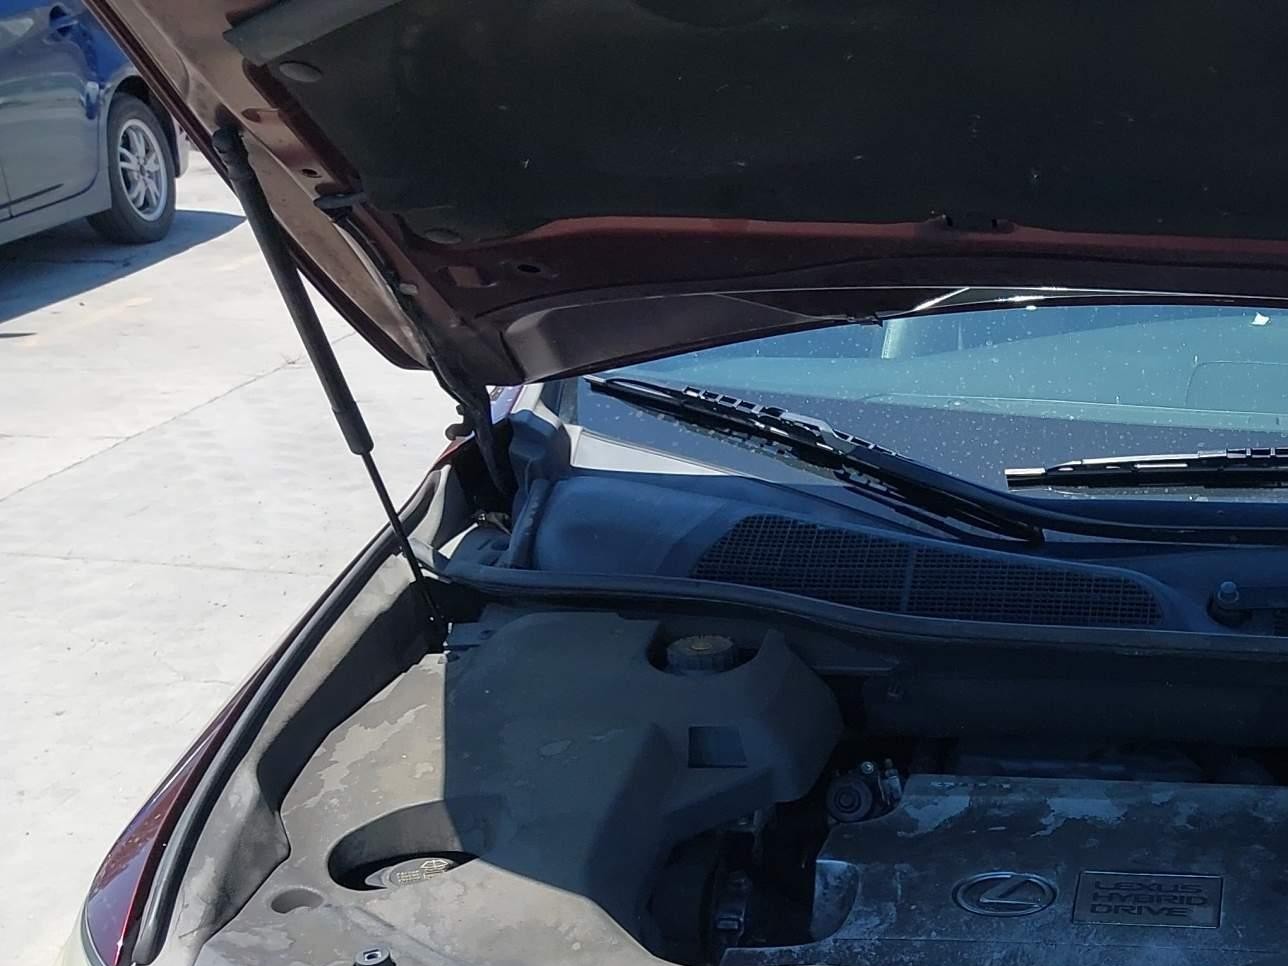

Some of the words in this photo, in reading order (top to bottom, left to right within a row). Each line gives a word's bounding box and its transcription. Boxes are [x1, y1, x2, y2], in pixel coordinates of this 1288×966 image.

[1094, 880, 1203, 895] LEXUS
[1092, 892, 1208, 906] HYBRID
[1090, 903, 1190, 916] DRIVE
